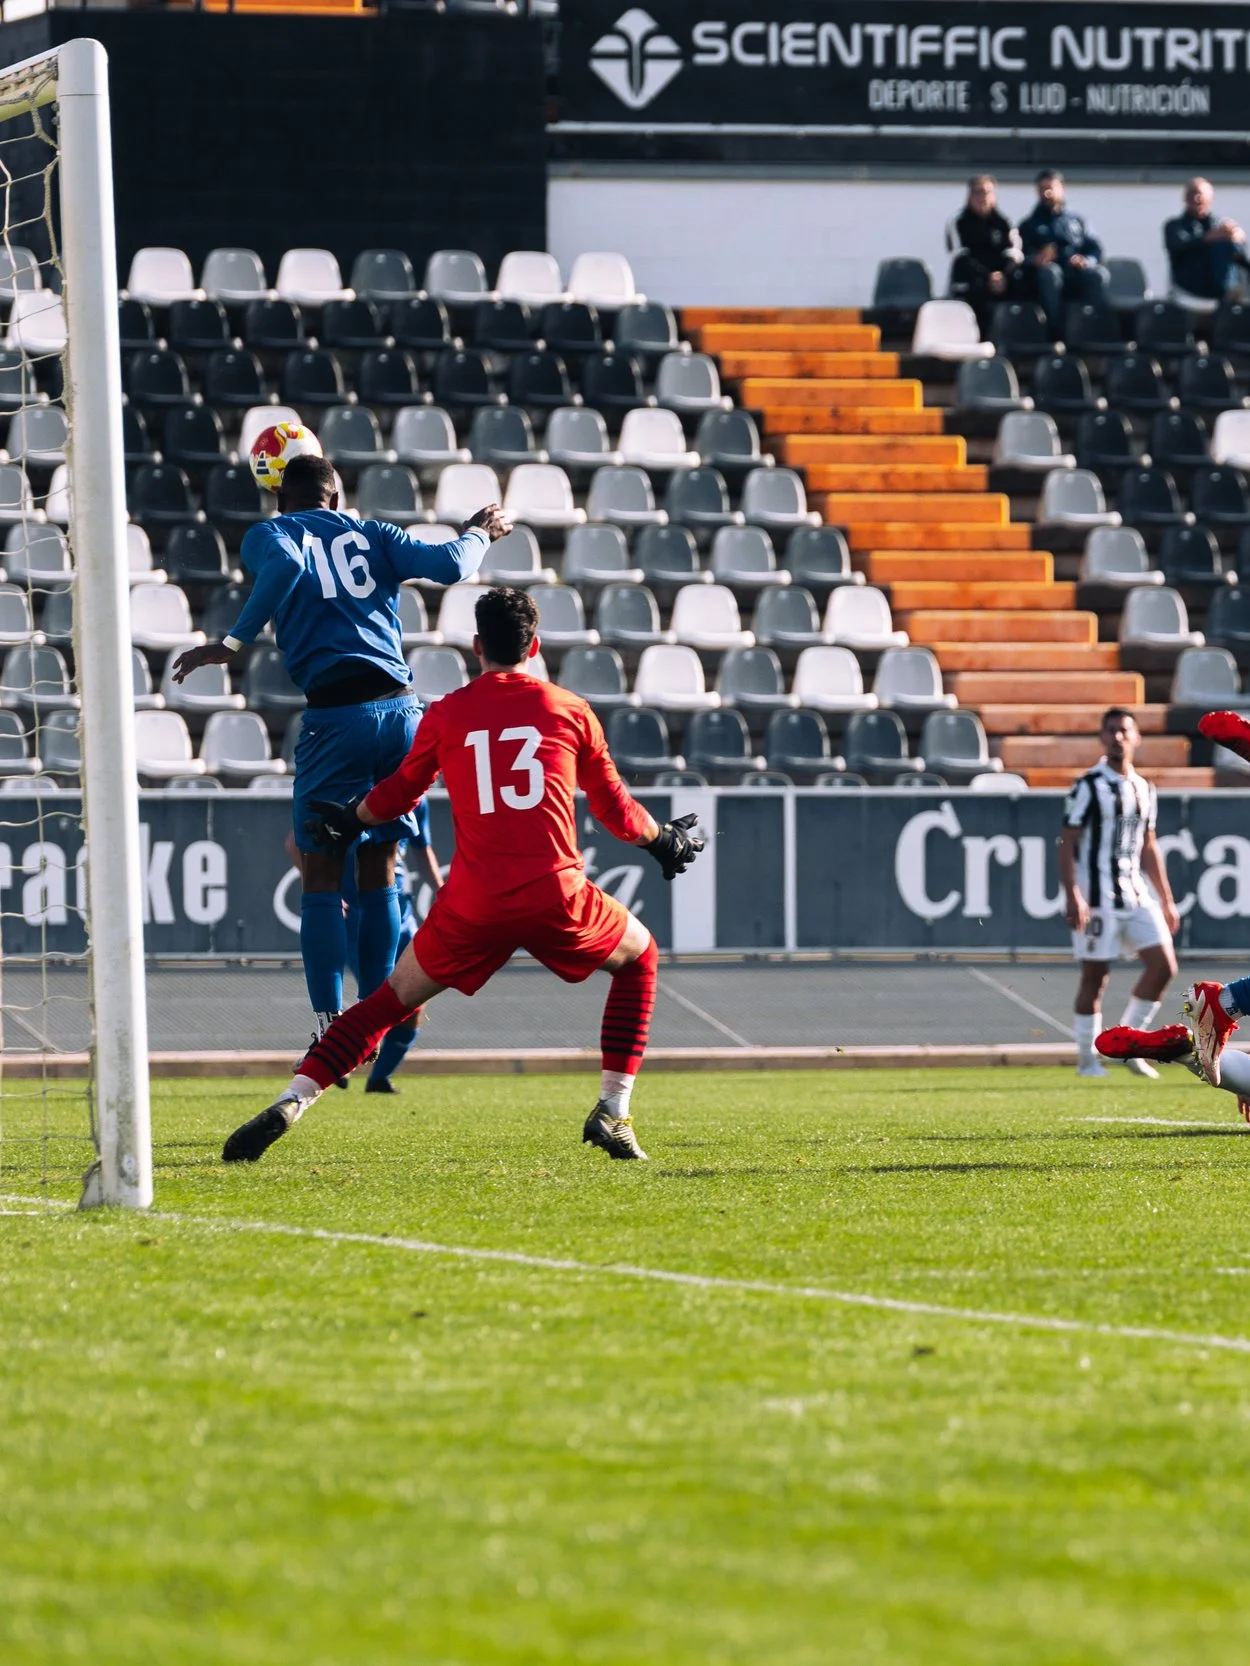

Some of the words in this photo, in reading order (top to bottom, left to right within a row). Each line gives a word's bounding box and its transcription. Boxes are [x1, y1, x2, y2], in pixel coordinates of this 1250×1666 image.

[692, 20, 1027, 70] SCIENTIFFIC
[868, 78, 970, 111] DEPORTE
[1086, 77, 1210, 116] NUTRICIÓN
[303, 531, 377, 599] 16
[464, 726, 545, 814] 13
